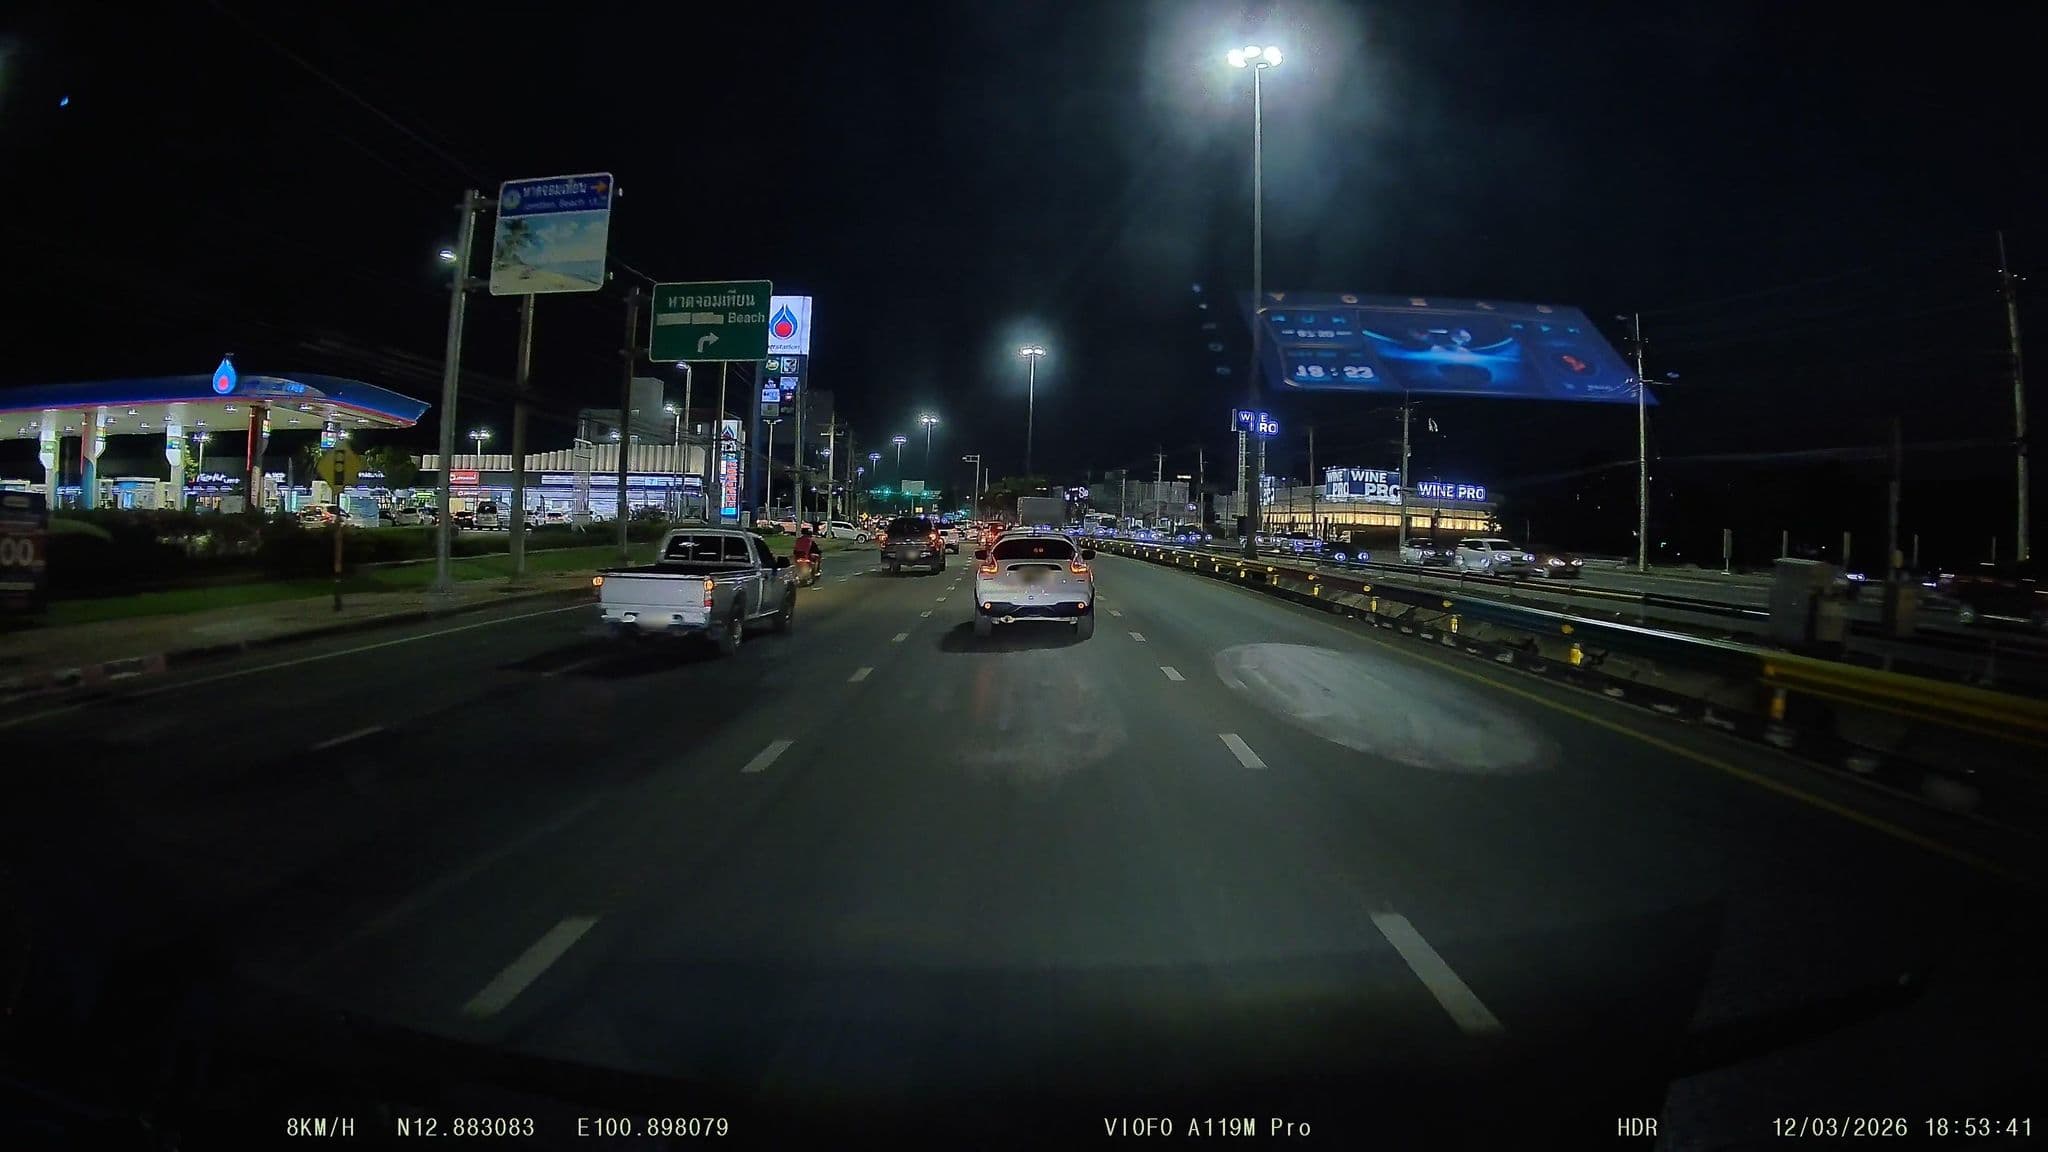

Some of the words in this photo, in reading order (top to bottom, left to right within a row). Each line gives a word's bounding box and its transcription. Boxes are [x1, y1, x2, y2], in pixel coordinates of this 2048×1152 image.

[728, 312, 765, 324] Beach
[1241, 413, 1269, 423] WIE
[1327, 470, 1343, 483] WINE
[1350, 470, 1388, 484] WINE
[1332, 483, 1349, 498] PRO
[1418, 483, 1454, 497] WINE
[1458, 485, 1486, 500] PRO
